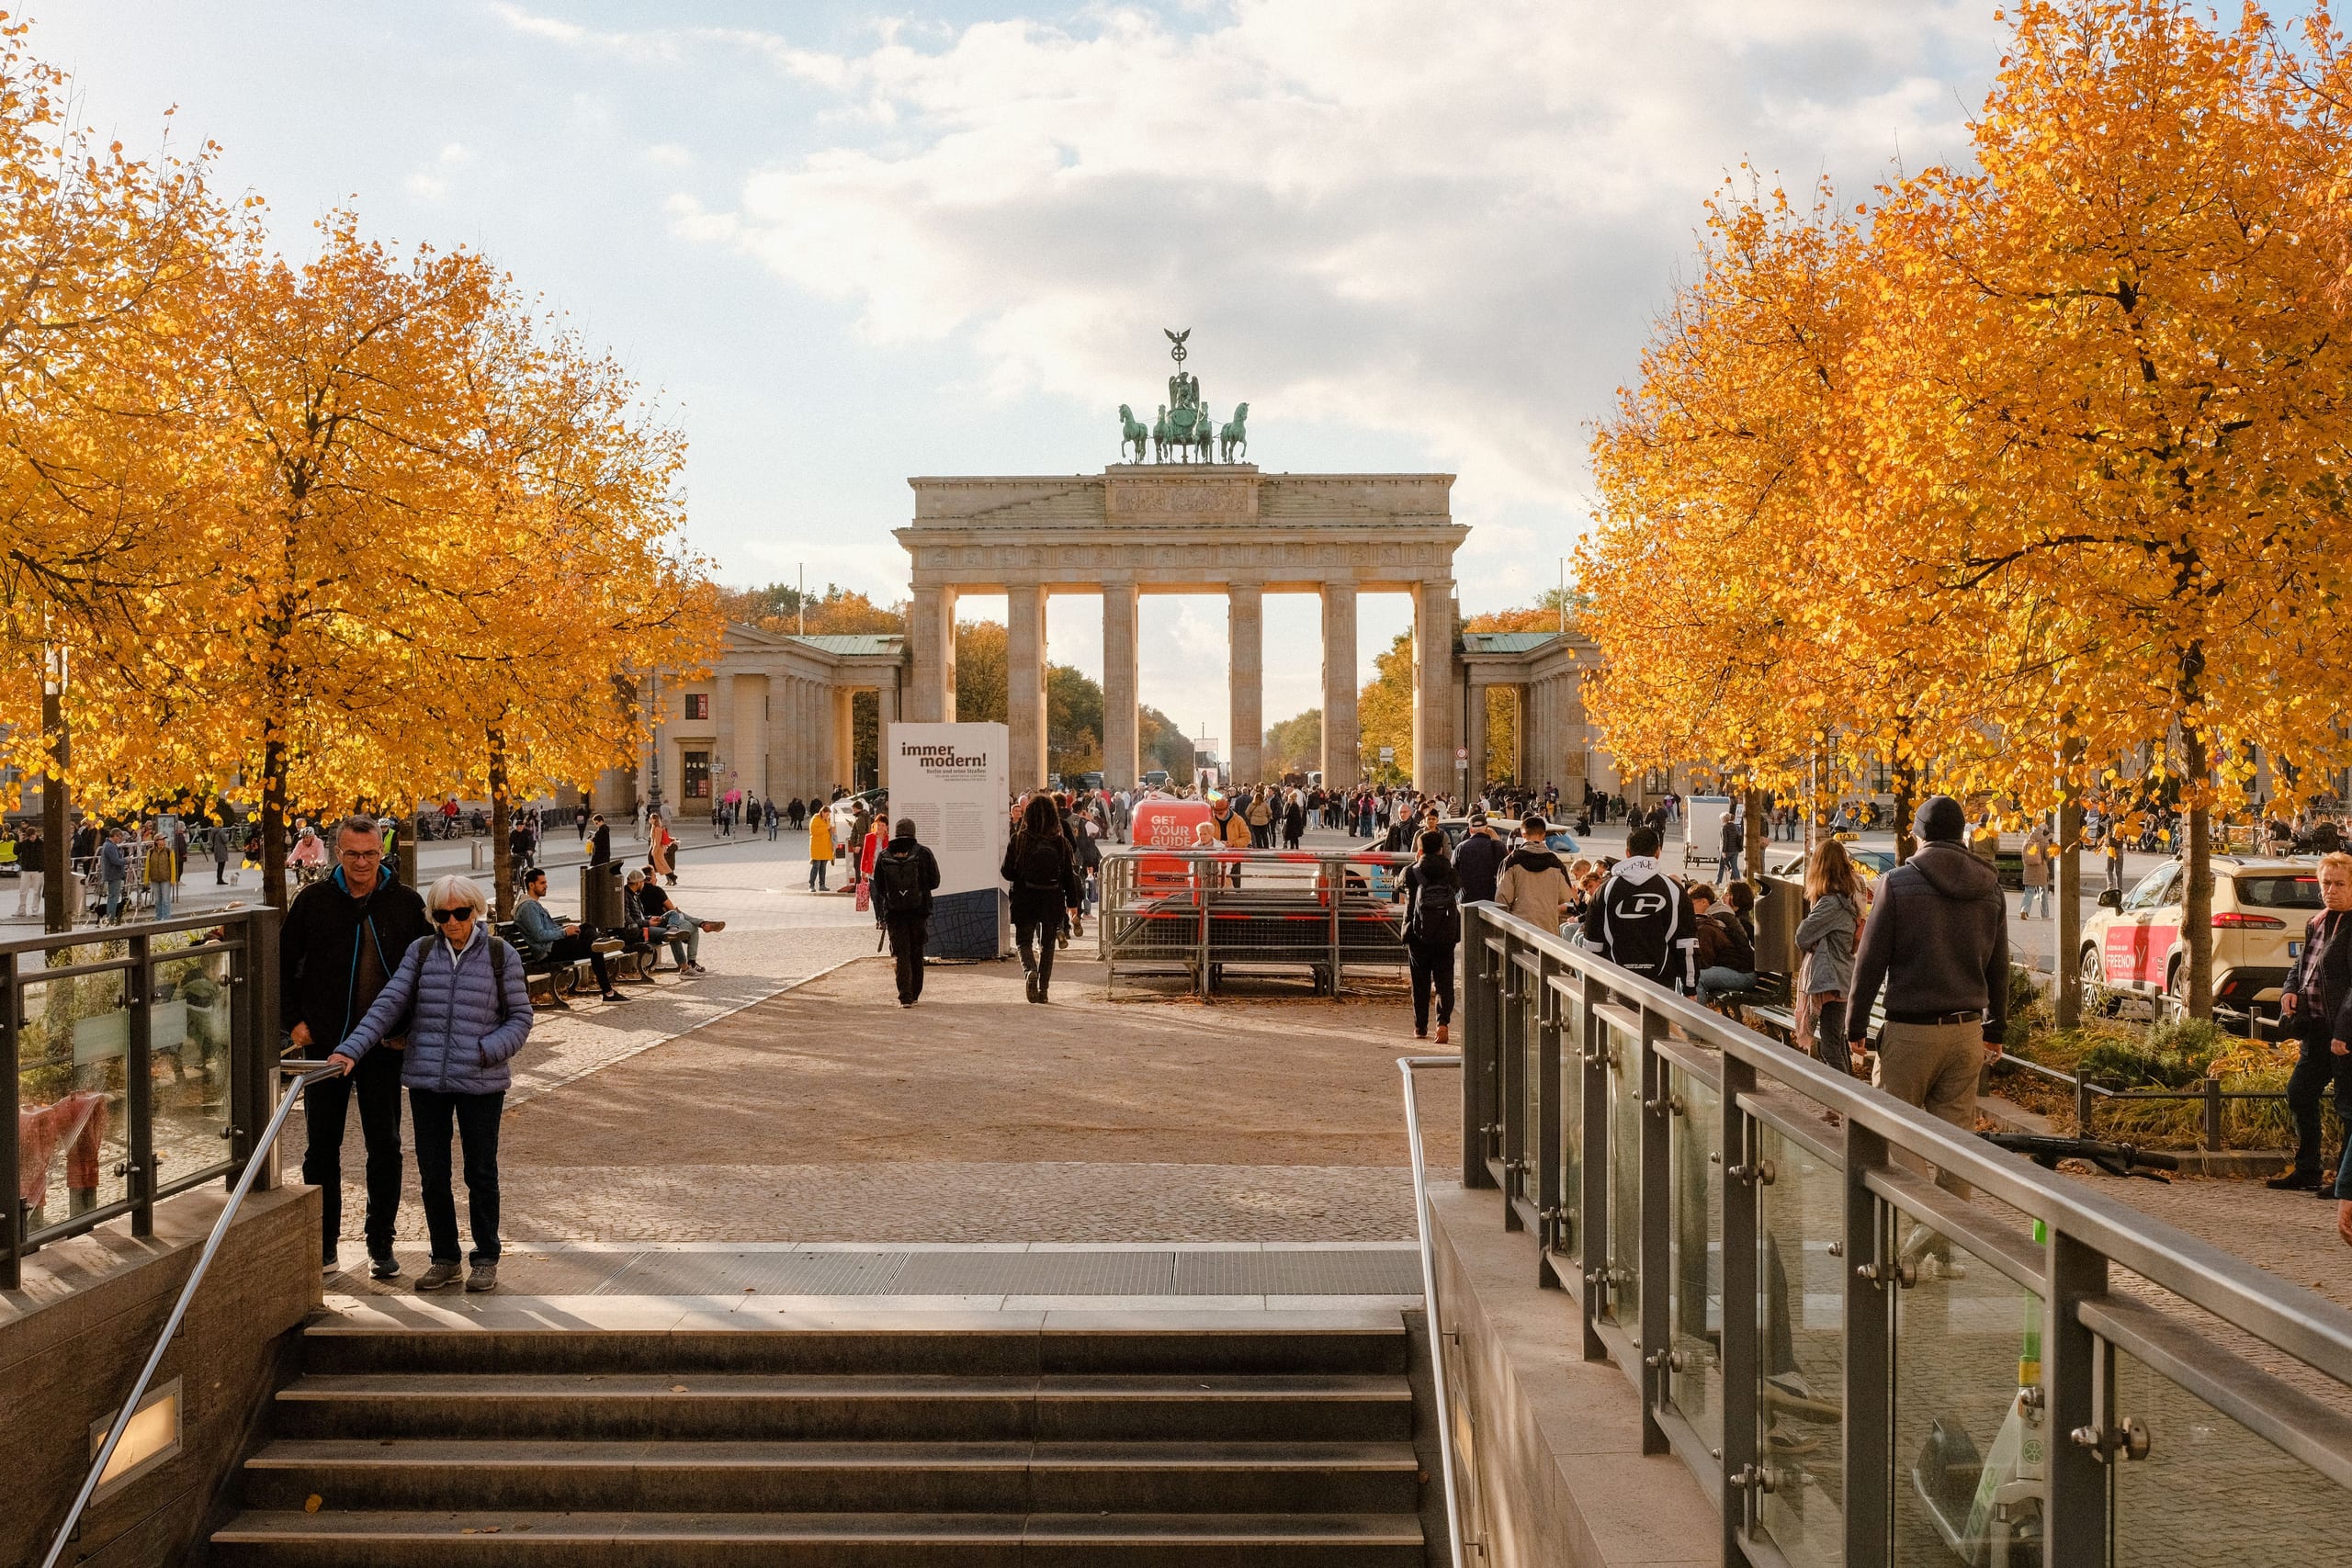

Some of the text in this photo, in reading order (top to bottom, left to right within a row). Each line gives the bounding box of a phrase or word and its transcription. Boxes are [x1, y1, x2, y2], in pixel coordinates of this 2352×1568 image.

[901, 742, 955, 756] immer
[920, 753, 987, 767] modern!
[1151, 815, 1177, 825] GET
[1151, 825, 1190, 836] YOUR
[1150, 836, 1193, 846] GUIDE
